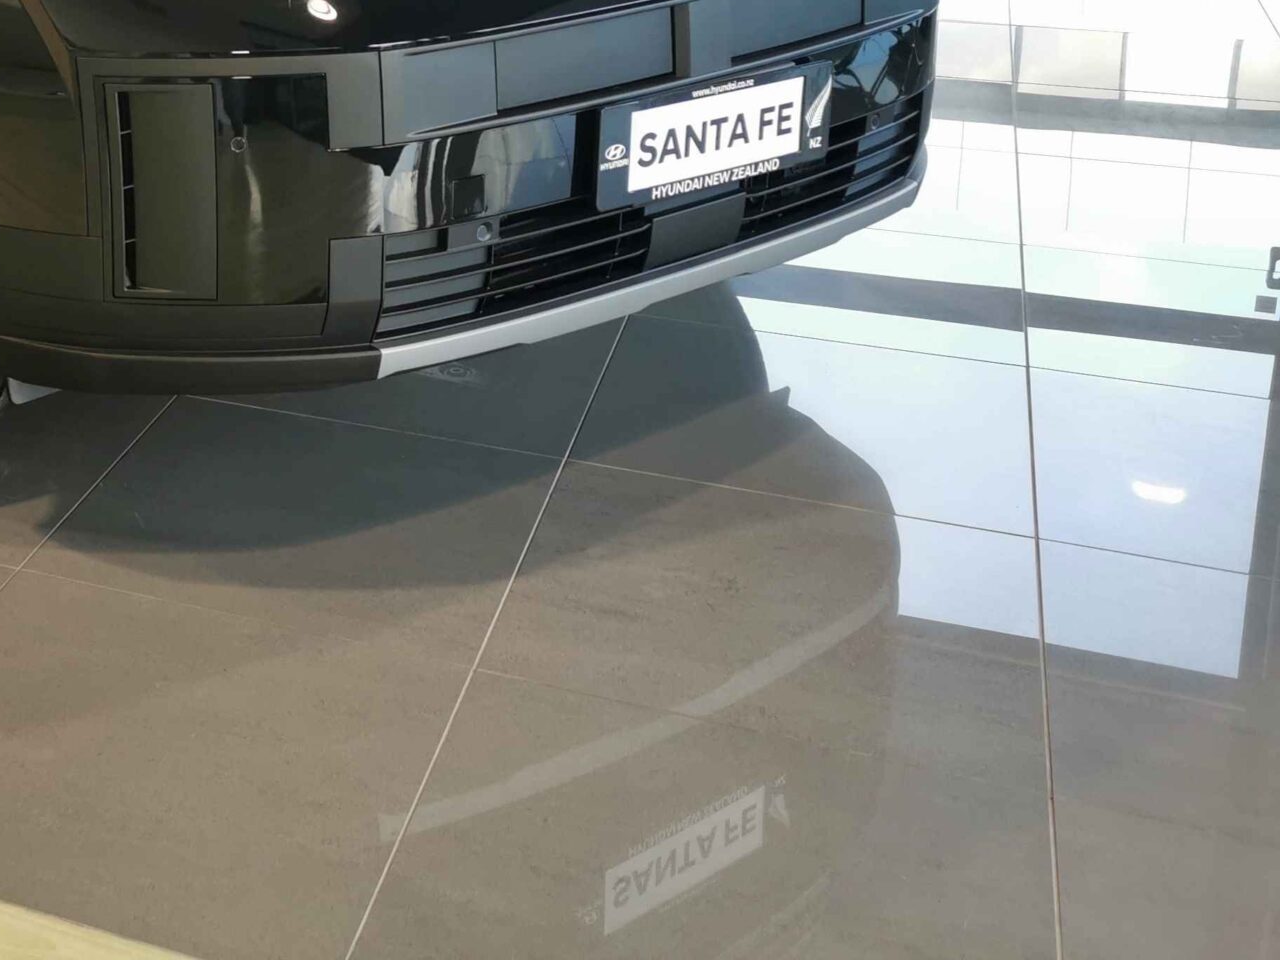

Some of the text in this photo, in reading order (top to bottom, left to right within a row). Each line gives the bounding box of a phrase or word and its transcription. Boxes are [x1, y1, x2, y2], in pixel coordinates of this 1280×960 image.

[691, 79, 755, 98] www.hyundai.co.nz
[637, 102, 794, 168] SANTA FE
[809, 136, 822, 149] NZ
[600, 158, 629, 171] HYUNDAI
[652, 158, 780, 200] HYUNDAI NEW ZEALAND
